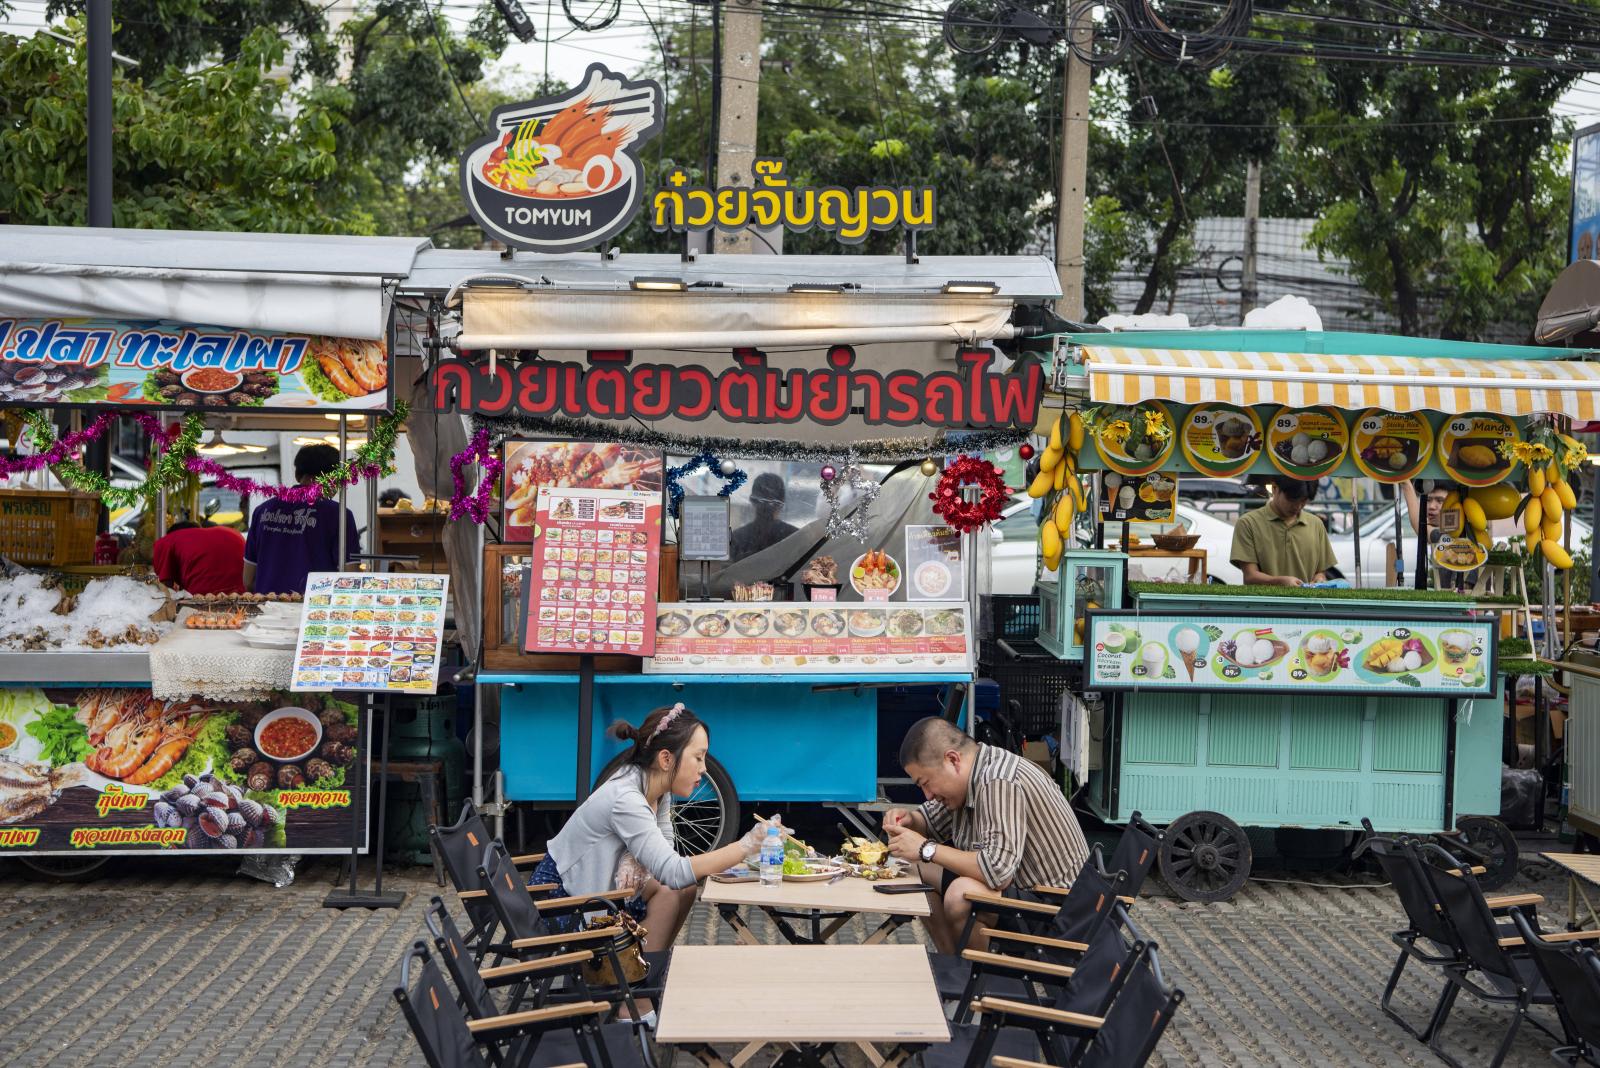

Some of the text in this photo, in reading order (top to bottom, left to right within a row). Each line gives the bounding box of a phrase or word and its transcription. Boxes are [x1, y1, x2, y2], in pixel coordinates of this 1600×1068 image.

[654, 160, 933, 238] ก๋วยจั๊บญวน
[504, 206, 592, 226] TOMYUM
[117, 330, 310, 374] ทะเลเผา
[1473, 421, 1511, 434] Mango
[98, 785, 146, 816] กุ้งเผา
[279, 791, 348, 806] หอยหวาน
[72, 829, 186, 846] หอยแครงลวก
